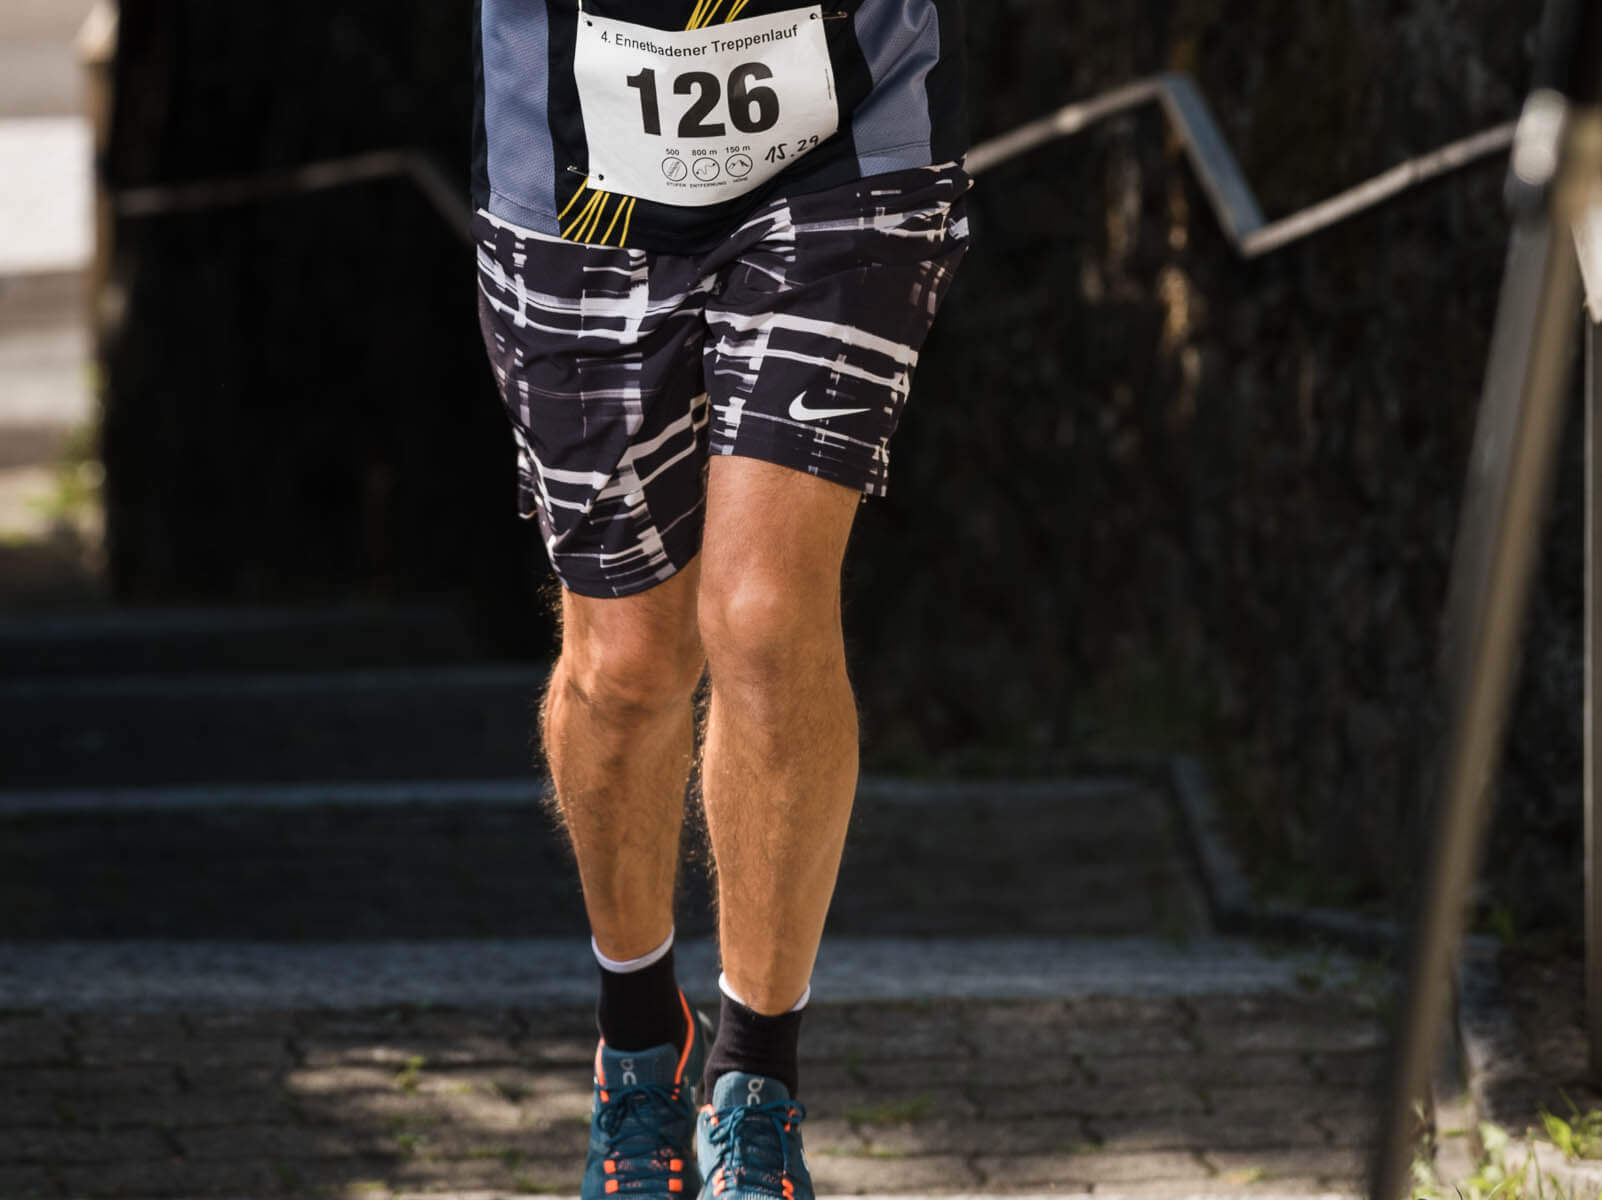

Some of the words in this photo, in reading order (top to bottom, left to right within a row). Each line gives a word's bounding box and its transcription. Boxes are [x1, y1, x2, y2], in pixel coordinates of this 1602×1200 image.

[600, 31, 611, 44] 4.
[615, 34, 707, 57] Ennetbadener
[711, 24, 798, 53] Treppenlauf
[626, 62, 780, 138] 126
[665, 148, 680, 156] 500
